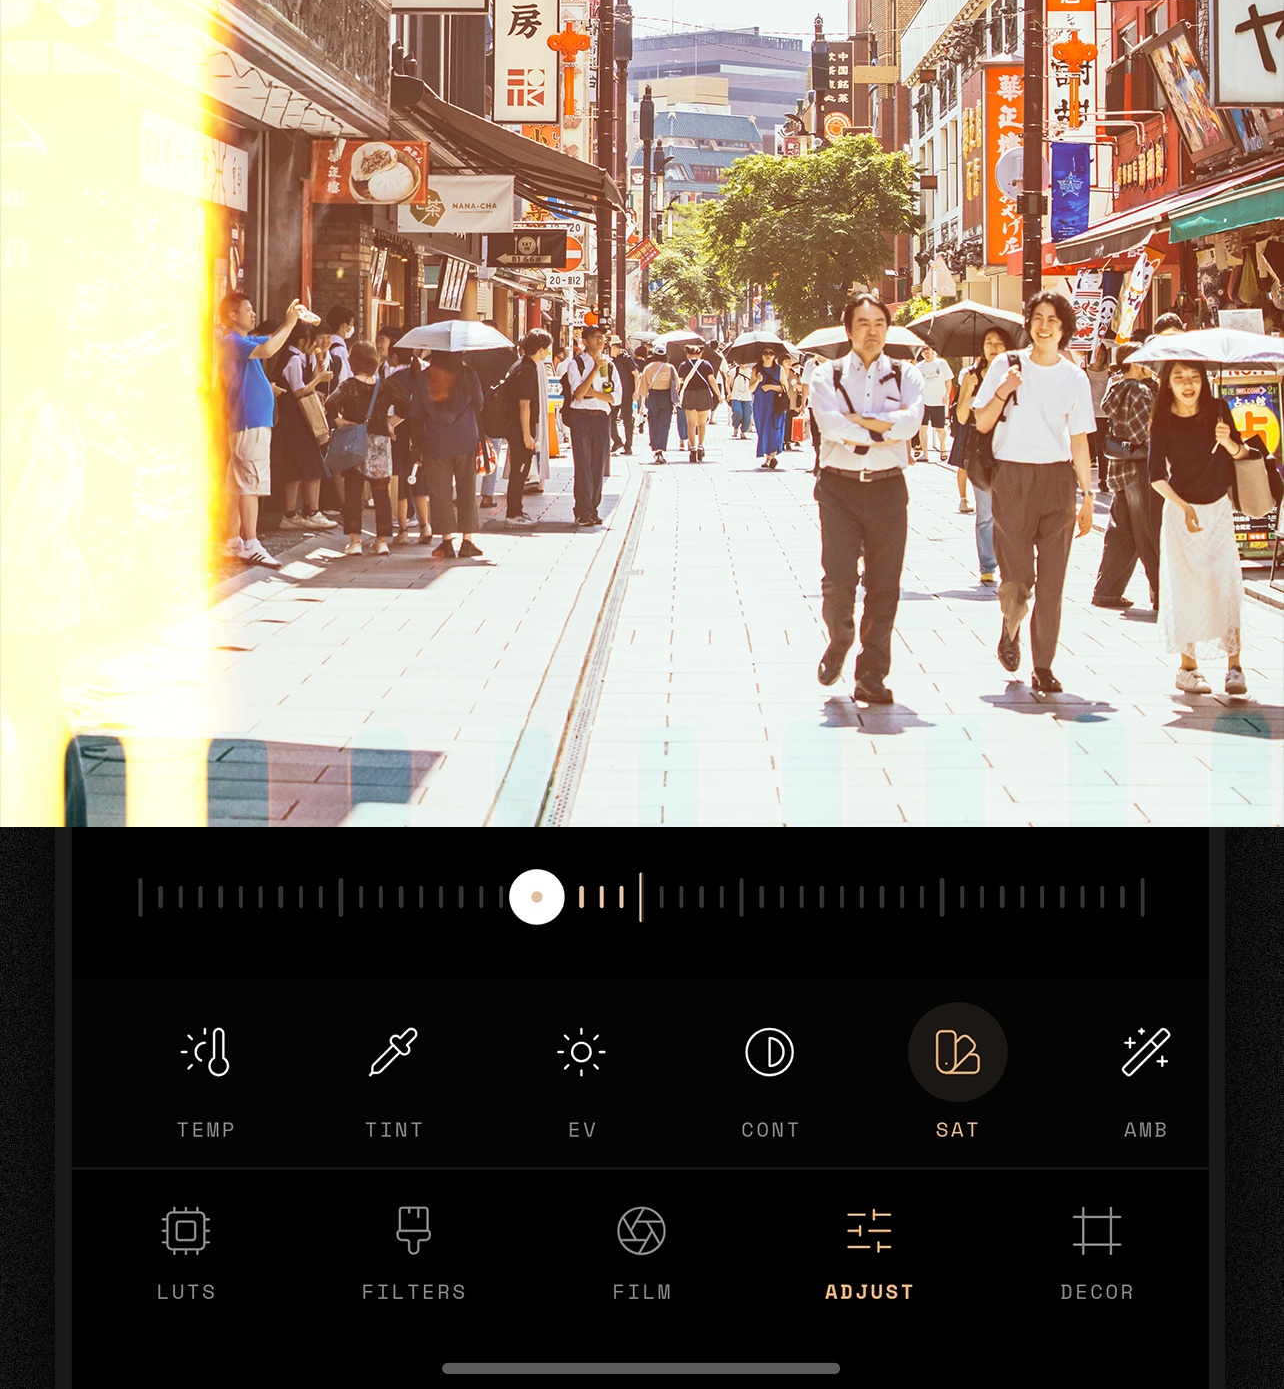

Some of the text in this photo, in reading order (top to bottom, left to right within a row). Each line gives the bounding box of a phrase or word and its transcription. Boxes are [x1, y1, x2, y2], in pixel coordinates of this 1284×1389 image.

[452, 202, 498, 210] NANA-CHA
[1267, 385, 1278, 395] 2F
[1233, 396, 1267, 408] 占い館
[177, 1121, 234, 1138] TEMP
[365, 1121, 423, 1138] TINT
[569, 1121, 596, 1138] EV
[741, 1121, 799, 1138] CONT
[935, 1121, 979, 1138] SAT
[1124, 1121, 1167, 1138] AMB
[157, 1284, 215, 1300] LUTS
[362, 1284, 465, 1300] FILTERS
[613, 1284, 670, 1300] FILM
[824, 1283, 913, 1300] ADJUST
[1060, 1284, 1133, 1300] DECOR
